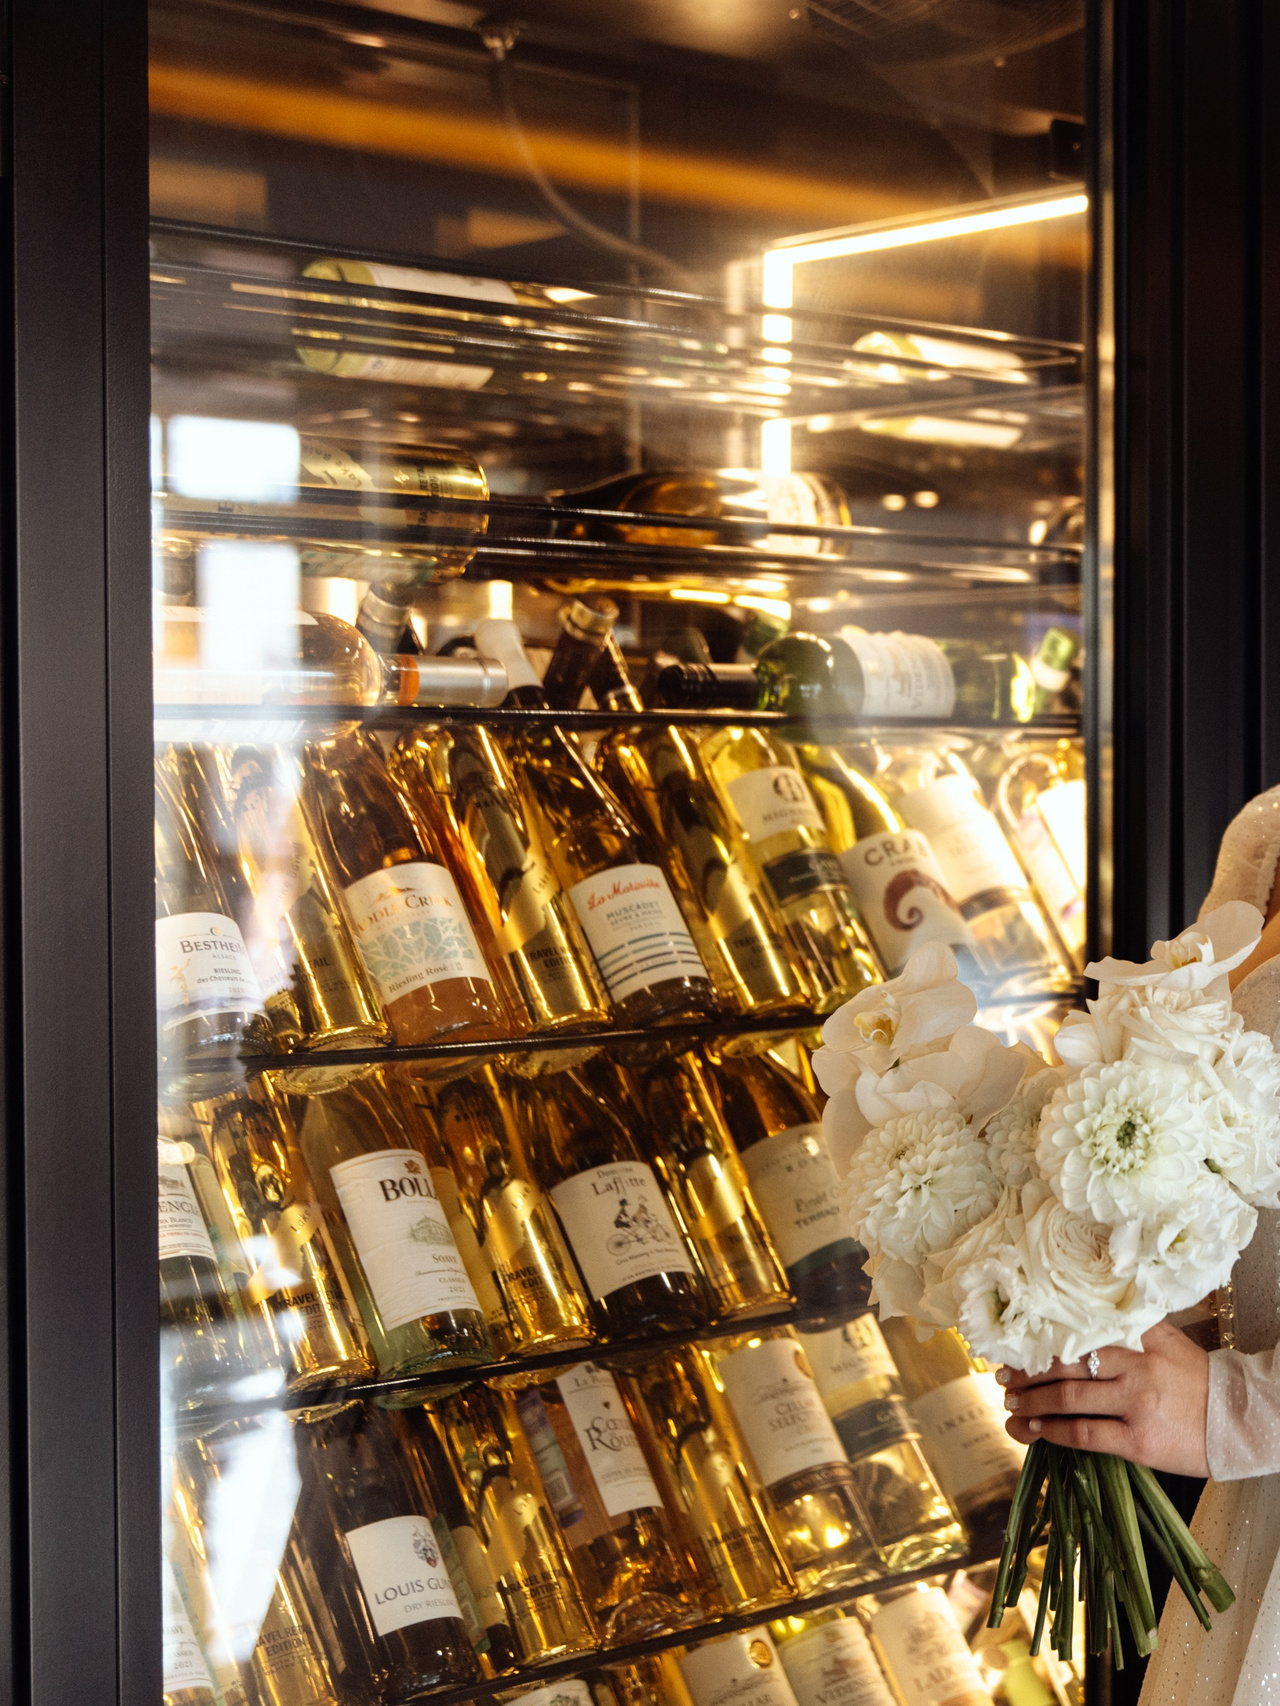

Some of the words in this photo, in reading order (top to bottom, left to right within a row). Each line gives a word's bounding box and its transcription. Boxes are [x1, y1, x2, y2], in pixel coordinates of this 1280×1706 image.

[388, 971, 424, 993] Riesling
[379, 1176, 439, 1202] BOLL
[374, 1579, 425, 1605] LOUIS
[404, 1602, 423, 1614] DRY
